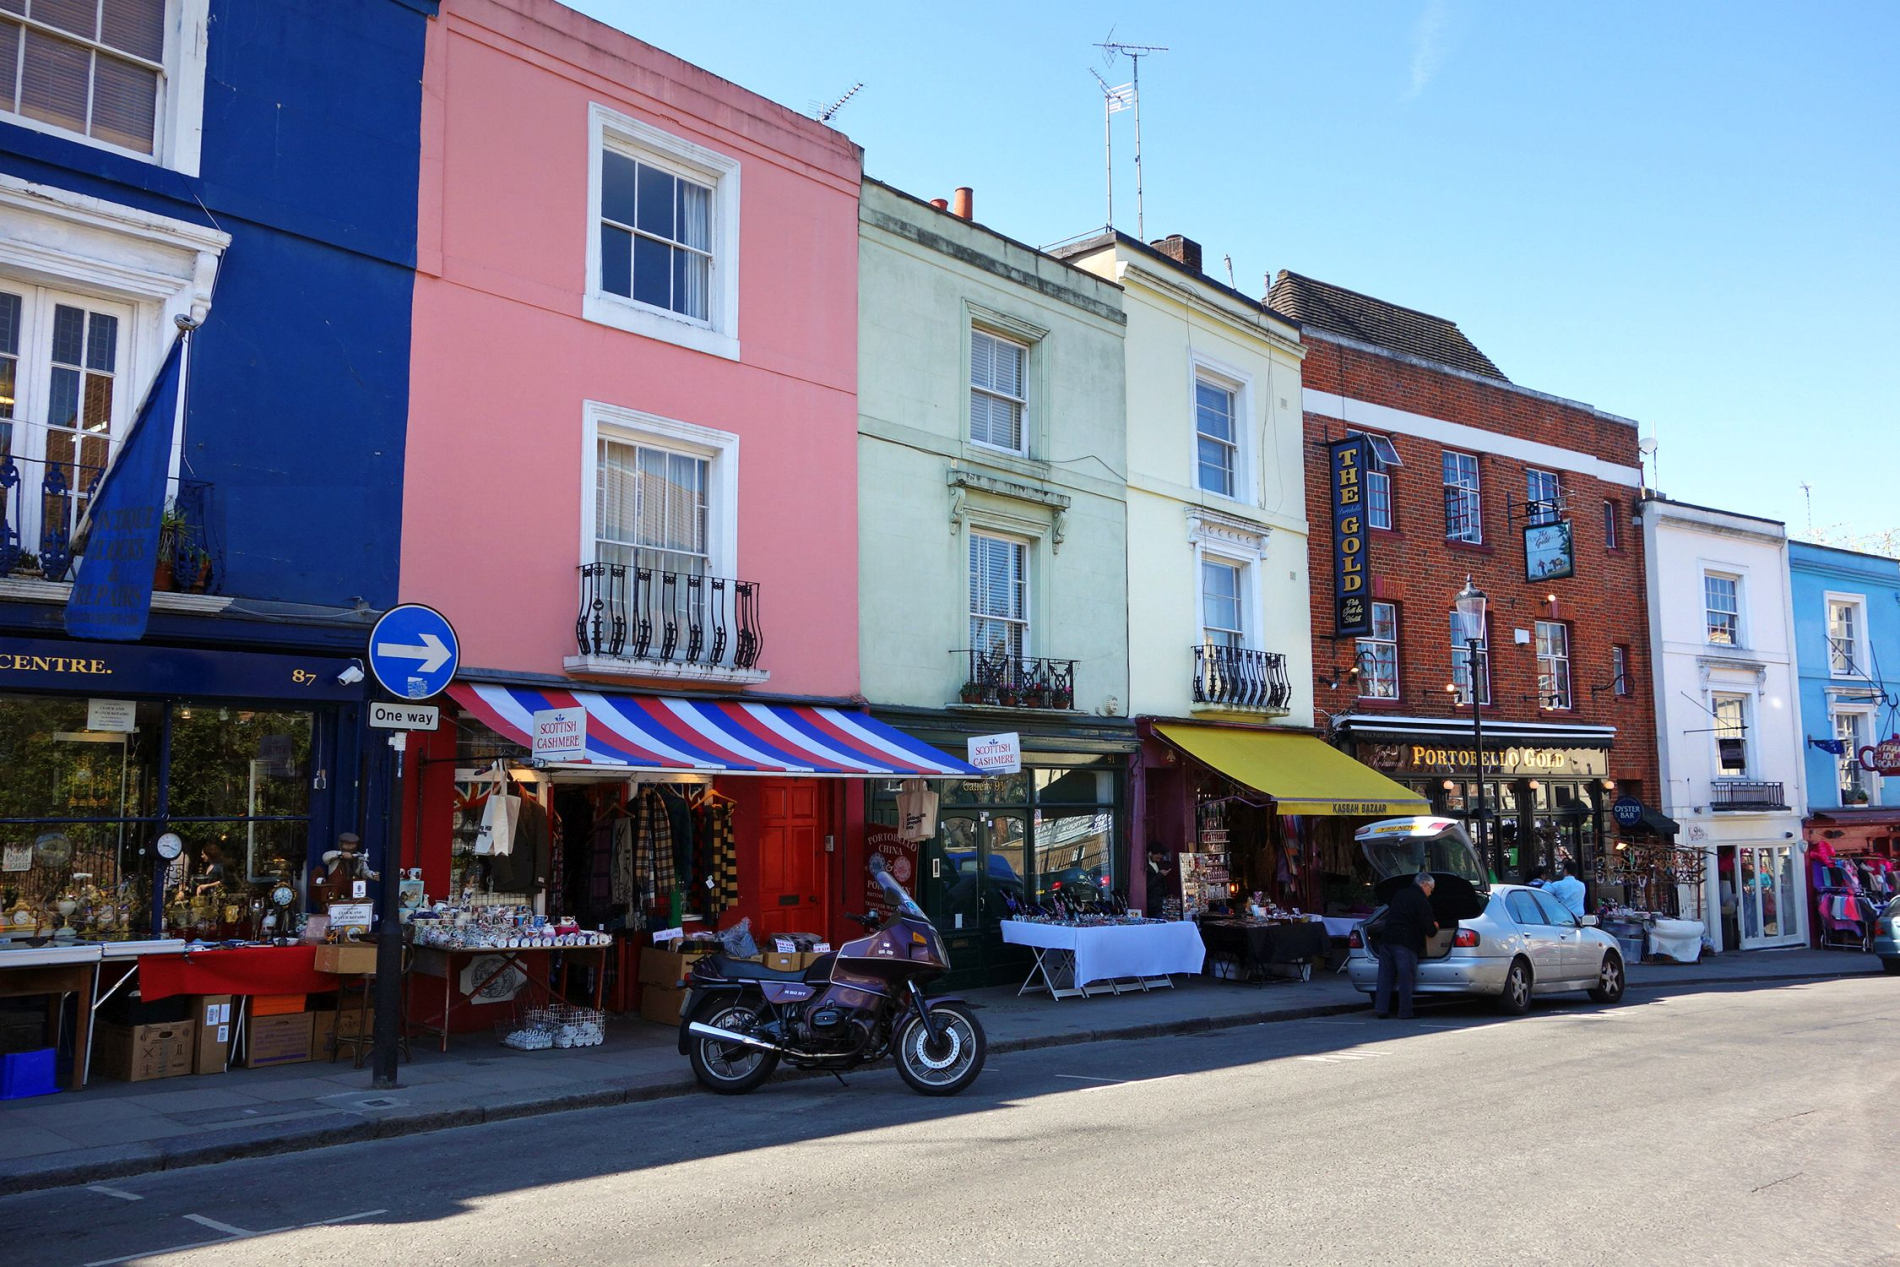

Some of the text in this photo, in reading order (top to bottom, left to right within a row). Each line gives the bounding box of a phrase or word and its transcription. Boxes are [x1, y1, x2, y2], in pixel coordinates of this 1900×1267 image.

[1338, 448, 1359, 505] THE
[1341, 516, 1362, 592] GOLD
[292, 669, 317, 687] 87
[375, 708, 433, 726] One way
[540, 720, 577, 735] SCOTTISH
[537, 735, 580, 749] CASHMERE
[975, 742, 1011, 756] SCOTTISH
[973, 753, 1015, 767] CASHMERE
[1107, 754, 1115, 764] 91
[1412, 746, 1519, 767] PORTOBELLO
[1524, 748, 1565, 768] GOLD
[1332, 803, 1387, 814] KASBAH BAZAAR
[1614, 805, 1641, 813] OYSTER
[878, 844, 903, 856] CHINA
[885, 860, 894, 873] &
